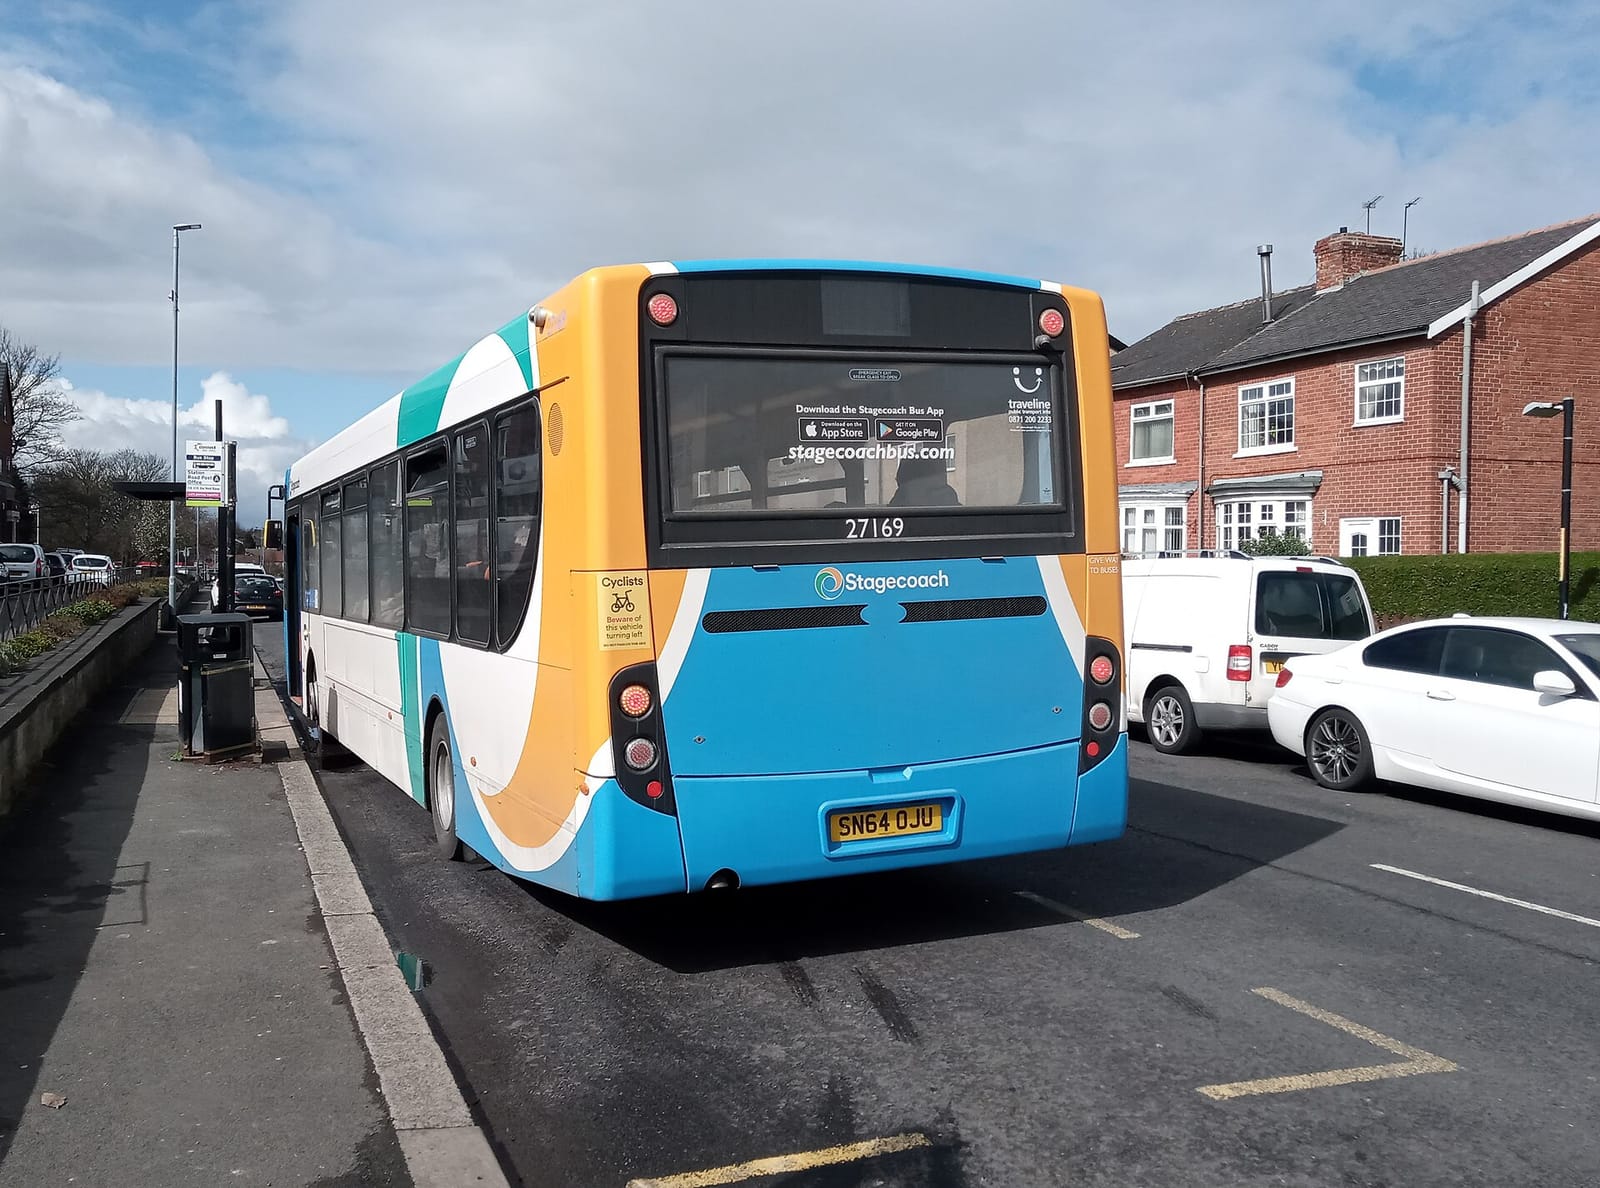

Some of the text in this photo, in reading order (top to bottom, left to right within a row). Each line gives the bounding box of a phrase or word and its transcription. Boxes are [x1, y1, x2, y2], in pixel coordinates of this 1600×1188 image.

[1008, 398, 1051, 409] traveline
[796, 404, 944, 417] Download the Stagecoach Bus App
[1008, 415, 1023, 423] 0871
[1038, 416, 1052, 424] 2233
[821, 428, 863, 439] App Store
[895, 428, 938, 439] Google Play
[788, 444, 955, 464] stagecoachbus.com
[845, 517, 904, 538] 27169
[601, 576, 644, 589] Cyclists
[845, 570, 949, 593] Stagecoach
[838, 806, 933, 836] SN64 OJU
